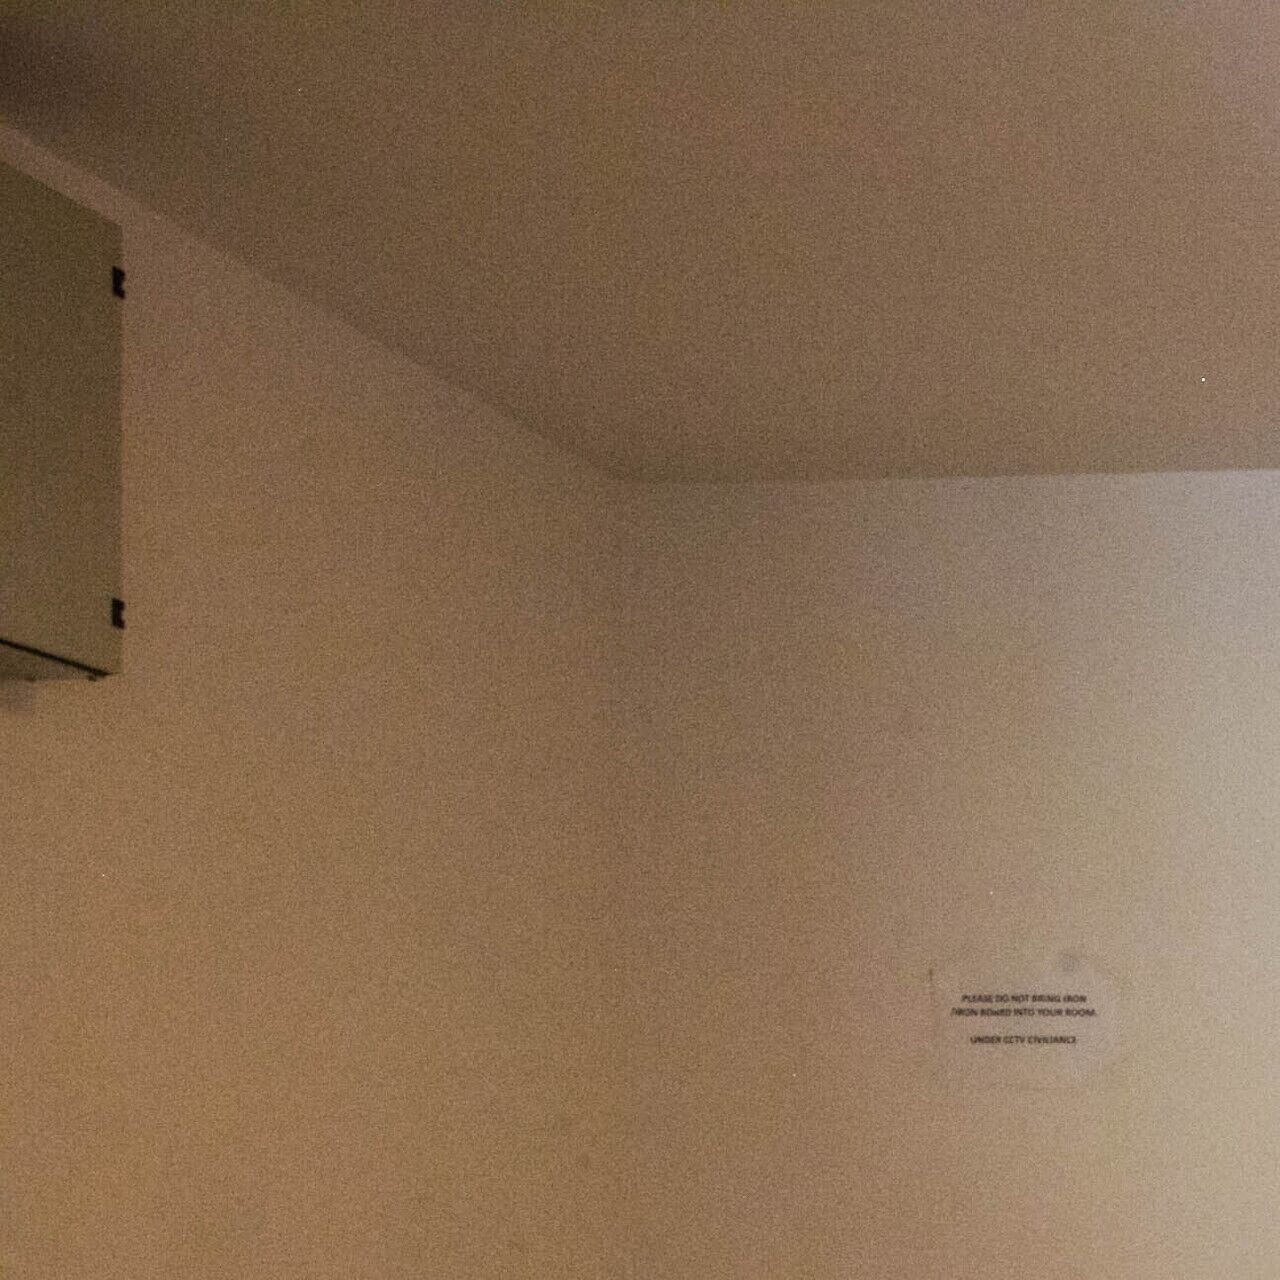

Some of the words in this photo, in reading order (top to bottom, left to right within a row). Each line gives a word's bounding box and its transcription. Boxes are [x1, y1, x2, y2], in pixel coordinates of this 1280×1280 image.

[962, 994, 993, 1003] PLEASE
[995, 994, 1009, 1003] DO
[1011, 994, 1029, 1003] NOT
[1013, 1008, 1035, 1016] INTO
[1038, 1008, 1063, 1016] YOUR
[1003, 1036, 1025, 1044] CCTV
